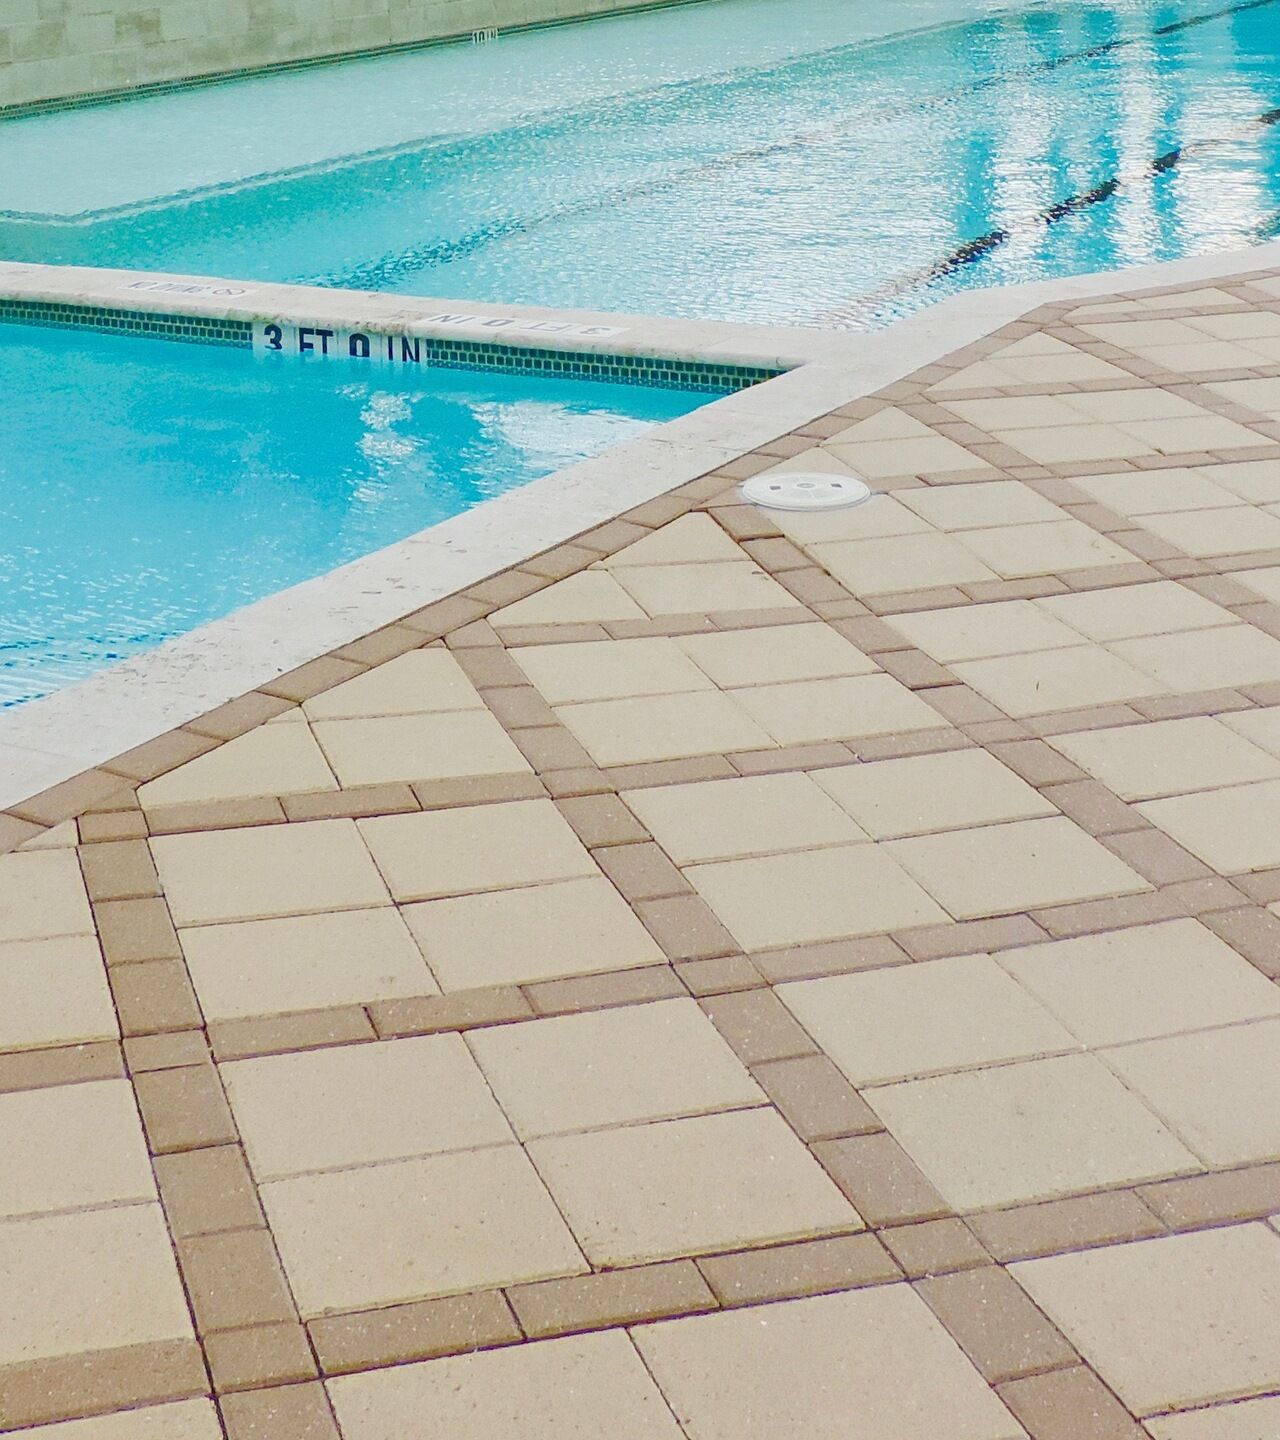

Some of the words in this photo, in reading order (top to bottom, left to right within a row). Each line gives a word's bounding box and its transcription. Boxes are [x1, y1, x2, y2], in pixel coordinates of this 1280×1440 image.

[264, 323, 283, 350] 3
[298, 327, 334, 355] FT
[387, 335, 420, 362] IN
